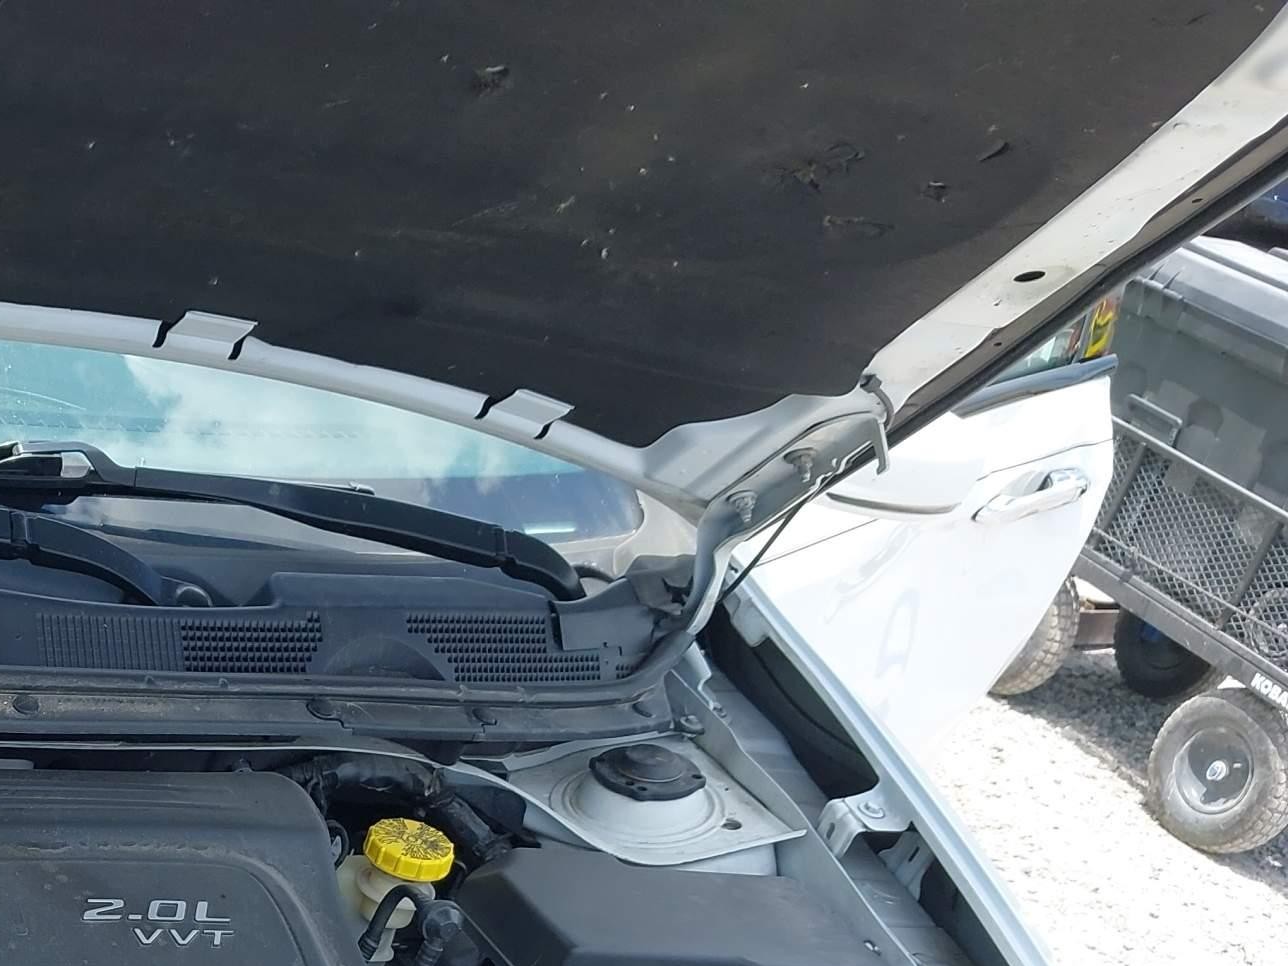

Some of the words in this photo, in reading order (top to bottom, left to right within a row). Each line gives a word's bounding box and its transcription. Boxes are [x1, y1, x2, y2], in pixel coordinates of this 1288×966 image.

[1251, 672, 1288, 709] KOBA
[81, 898, 232, 923] 2.0L
[132, 927, 234, 947] VVT
